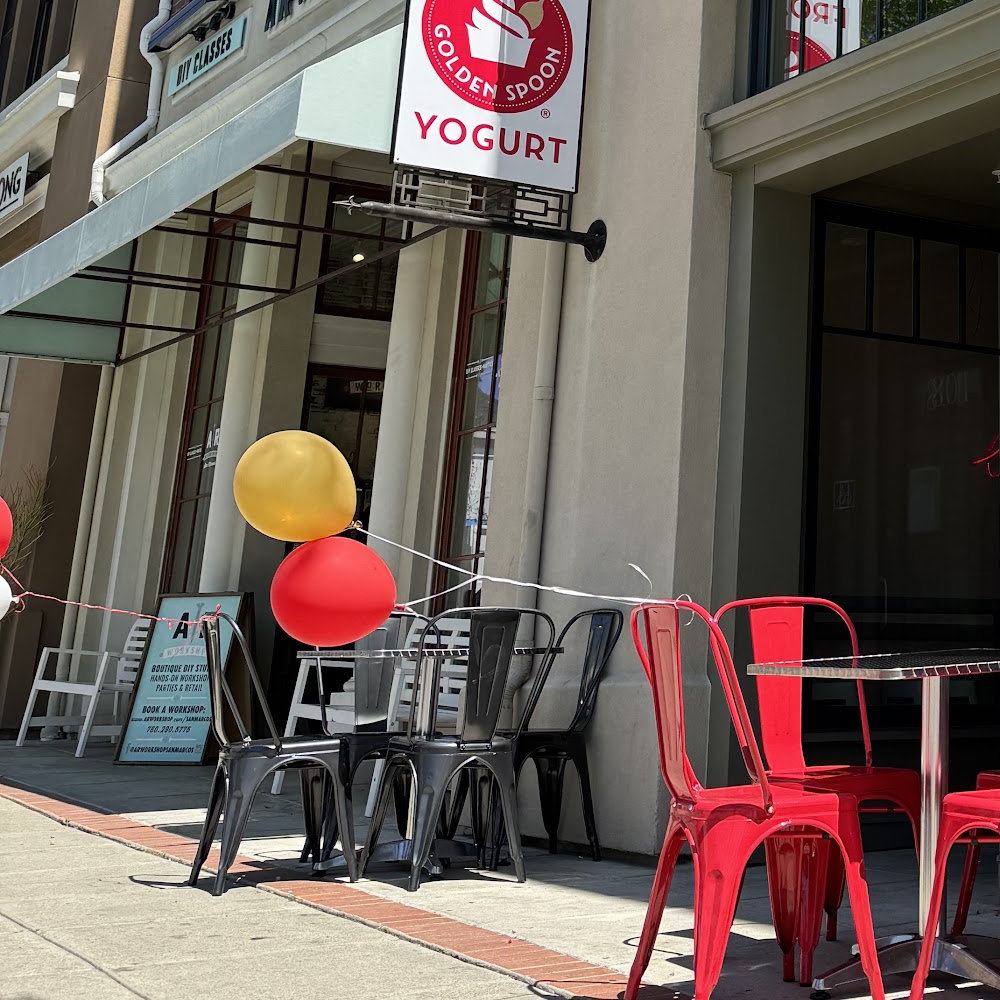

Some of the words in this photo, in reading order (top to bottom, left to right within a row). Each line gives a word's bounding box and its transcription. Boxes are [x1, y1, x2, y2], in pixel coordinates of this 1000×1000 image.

[176, 57, 192, 87] DIY
[193, 27, 233, 75] CLASSES
[434, 24, 497, 99] GOLDEN
[505, 47, 562, 101] SPOON
[414, 111, 568, 164] YOGURT
[151, 664, 182, 673] BOUTIQUE
[183, 664, 194, 673] DIY
[195, 664, 209, 673] STU
[179, 674, 209, 682] WORKSHO
[155, 684, 178, 692] PARTIES
[184, 684, 203, 692] RETAIL
[142, 705, 161, 714] BOOK
[161, 705, 167, 714] A
[168, 705, 206, 714] WORKSHOP:
